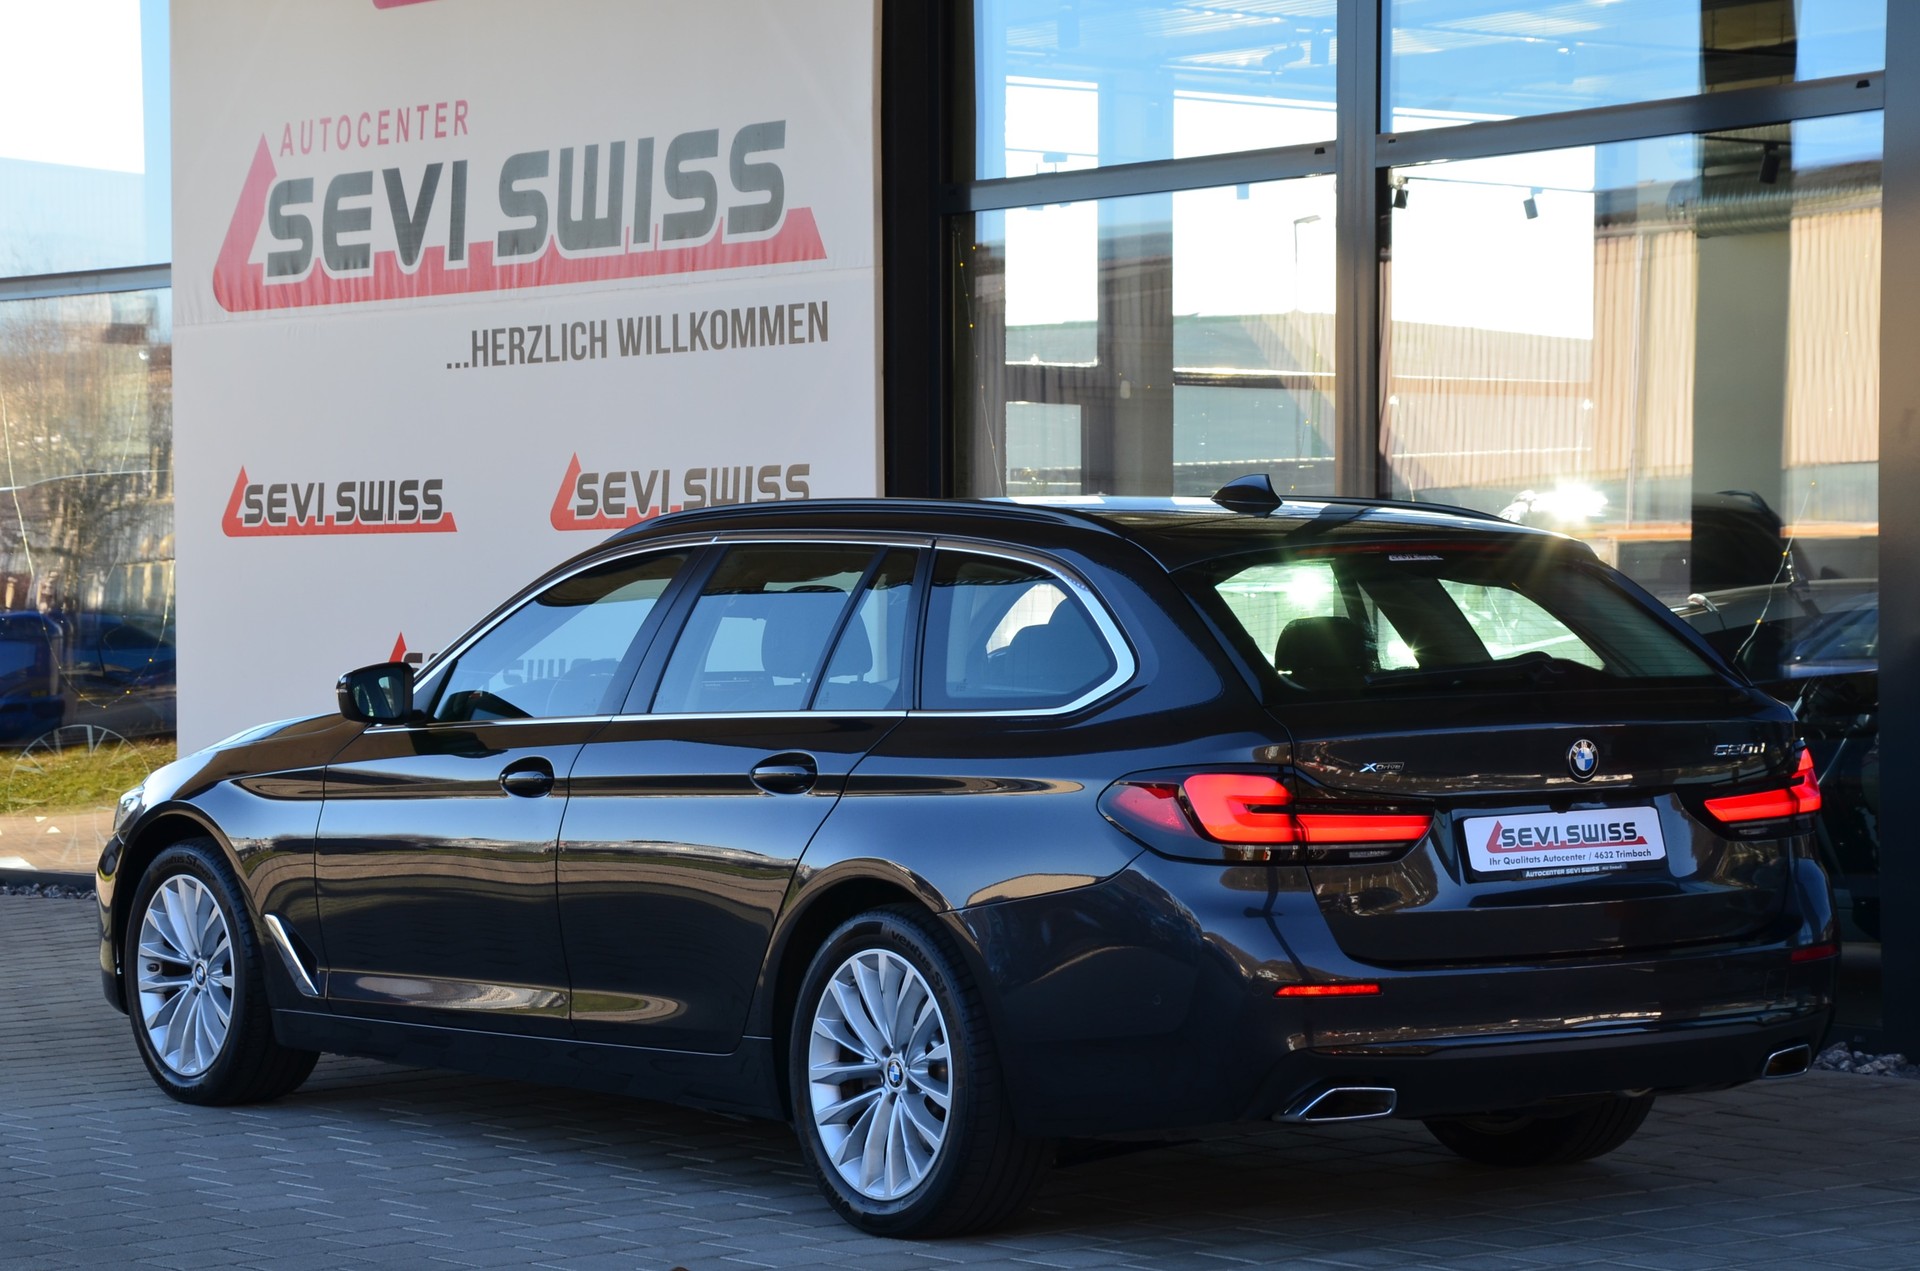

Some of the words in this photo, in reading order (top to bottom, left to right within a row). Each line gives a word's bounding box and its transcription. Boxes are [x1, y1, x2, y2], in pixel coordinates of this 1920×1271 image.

[280, 100, 469, 157] AUTOCENTER
[266, 160, 468, 278] SEVI
[498, 120, 787, 256] SWISS
[446, 320, 608, 370] ...HERZLICH
[617, 301, 829, 356] WILLKOMMEN
[244, 482, 325, 524] SEVI
[336, 479, 443, 522] SWISS
[576, 469, 671, 517] SEVI
[684, 463, 811, 510] SWISS
[1489, 857, 1501, 866] Ihr
[1543, 853, 1586, 863] Autocenter
[1594, 851, 1614, 860] 4632
[1616, 848, 1652, 858] Trimbach
[1501, 826, 1559, 848] SEVI
[1566, 822, 1638, 844] SWISS
